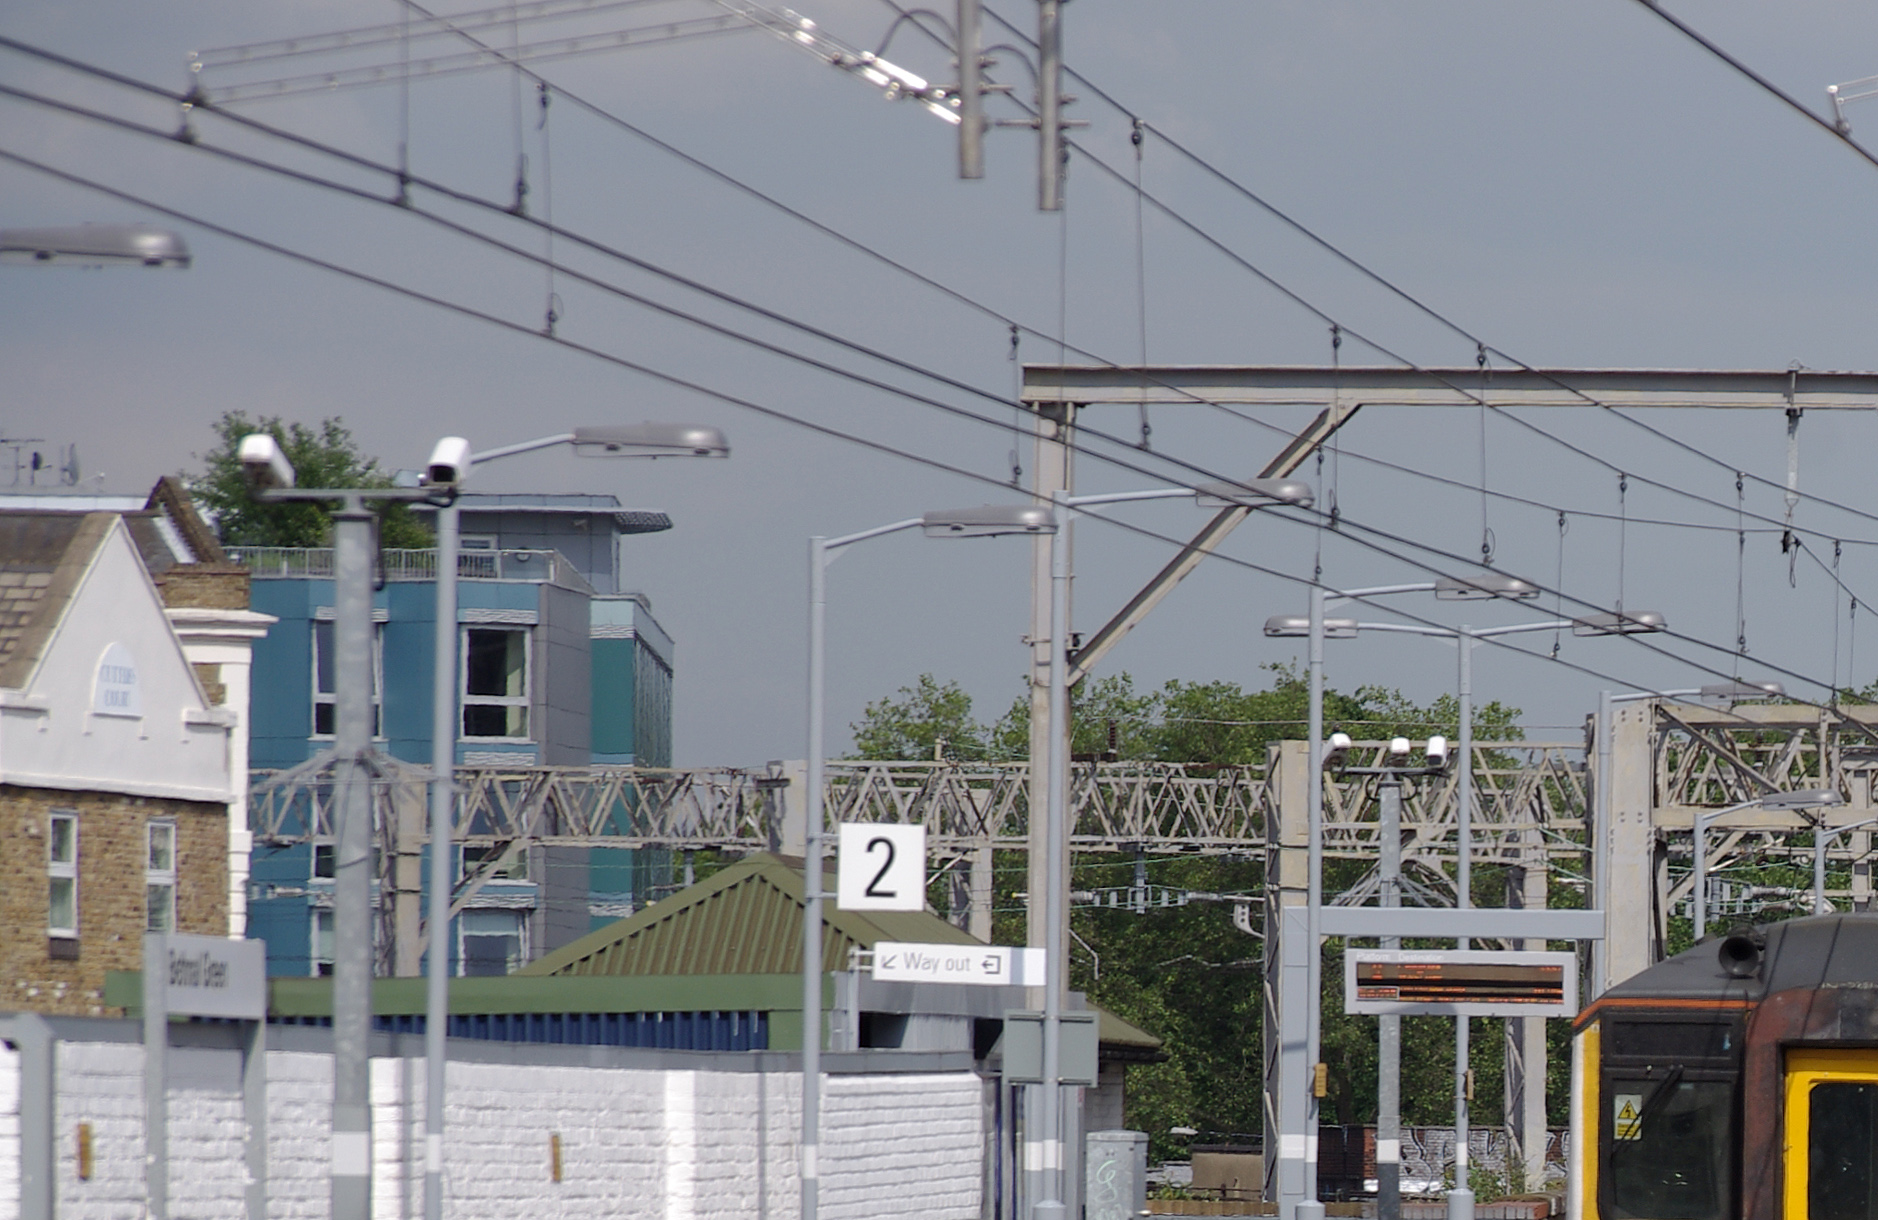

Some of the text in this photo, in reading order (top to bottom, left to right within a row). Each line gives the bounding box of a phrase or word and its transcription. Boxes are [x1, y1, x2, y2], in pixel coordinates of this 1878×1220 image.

[865, 836, 897, 898] 2
[904, 951, 971, 974] Way out
[1398, 953, 1444, 963] Destination
